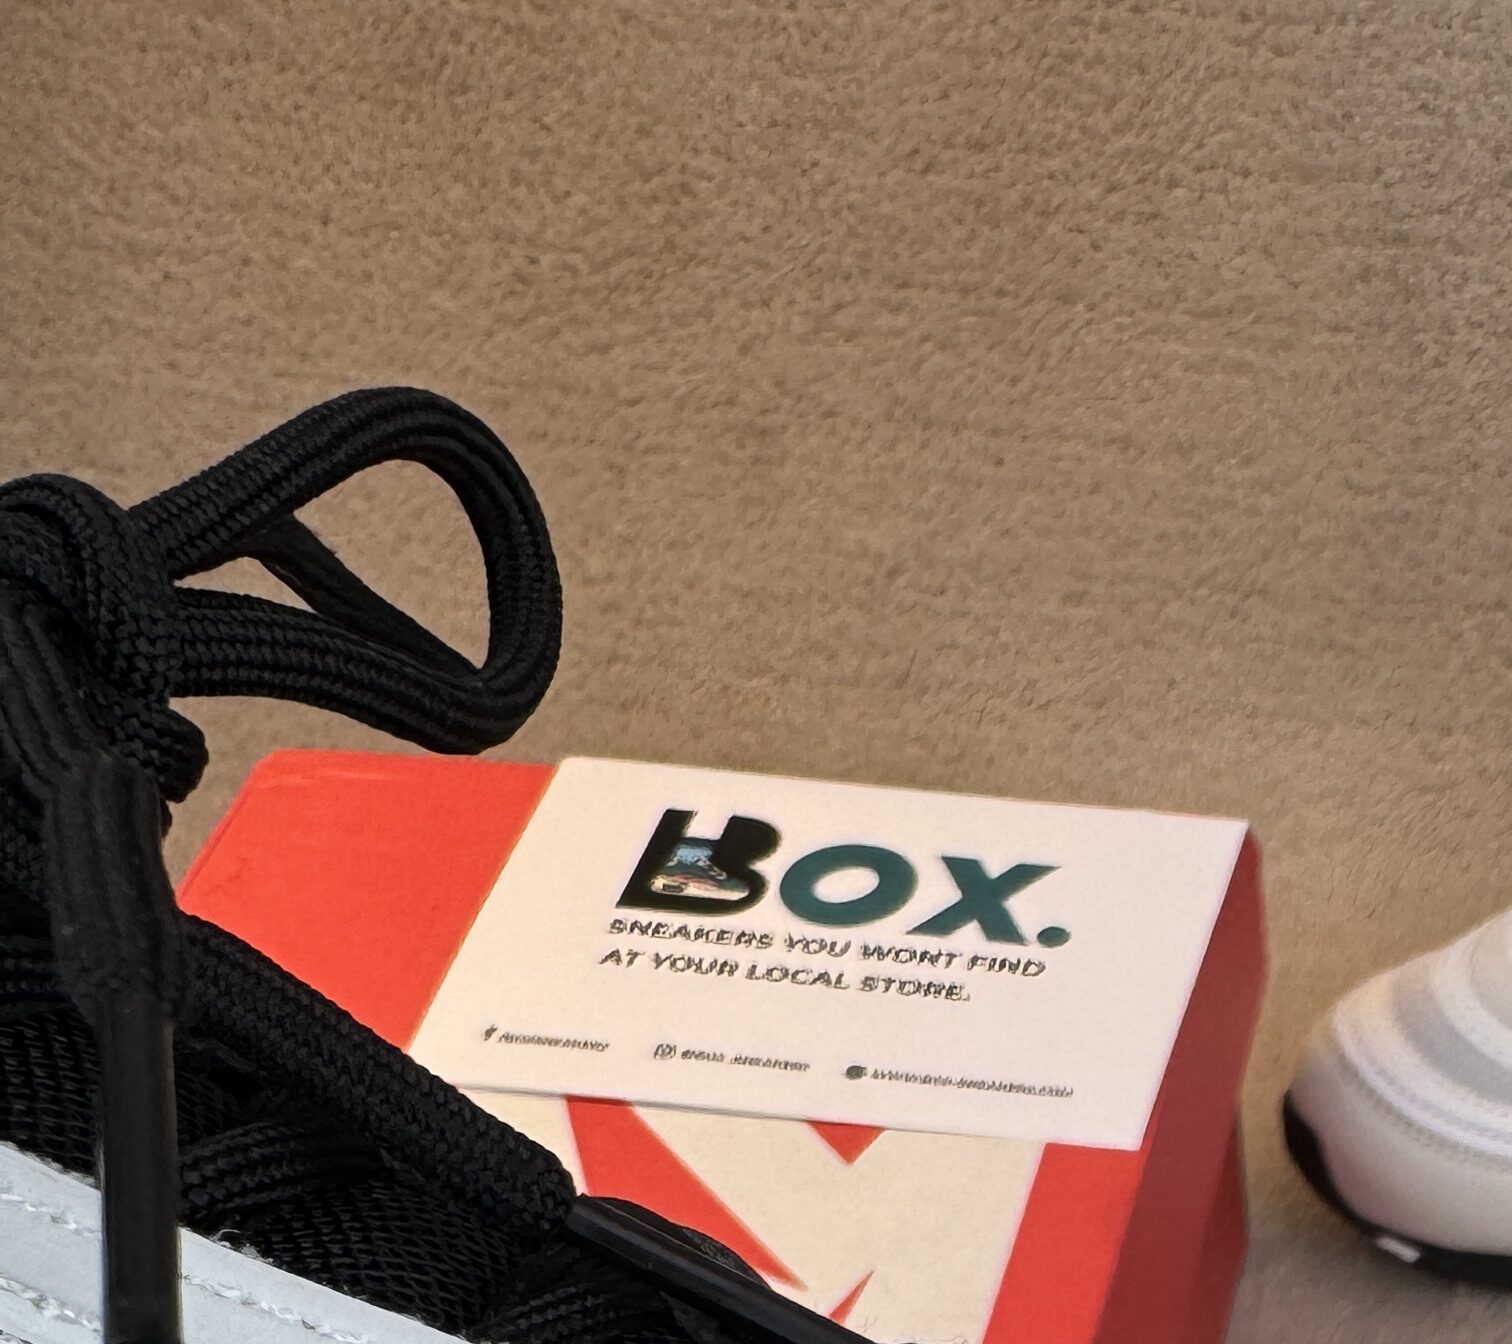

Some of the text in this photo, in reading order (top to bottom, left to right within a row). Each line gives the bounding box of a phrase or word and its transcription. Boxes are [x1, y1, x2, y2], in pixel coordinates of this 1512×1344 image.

[599, 948, 645, 967] AT
[653, 951, 739, 977] YOUR
[746, 961, 851, 990] LOCAL
[609, 918, 774, 949] SNEAKERS
[784, 932, 851, 957] YOU
[966, 953, 1047, 977] FIND
